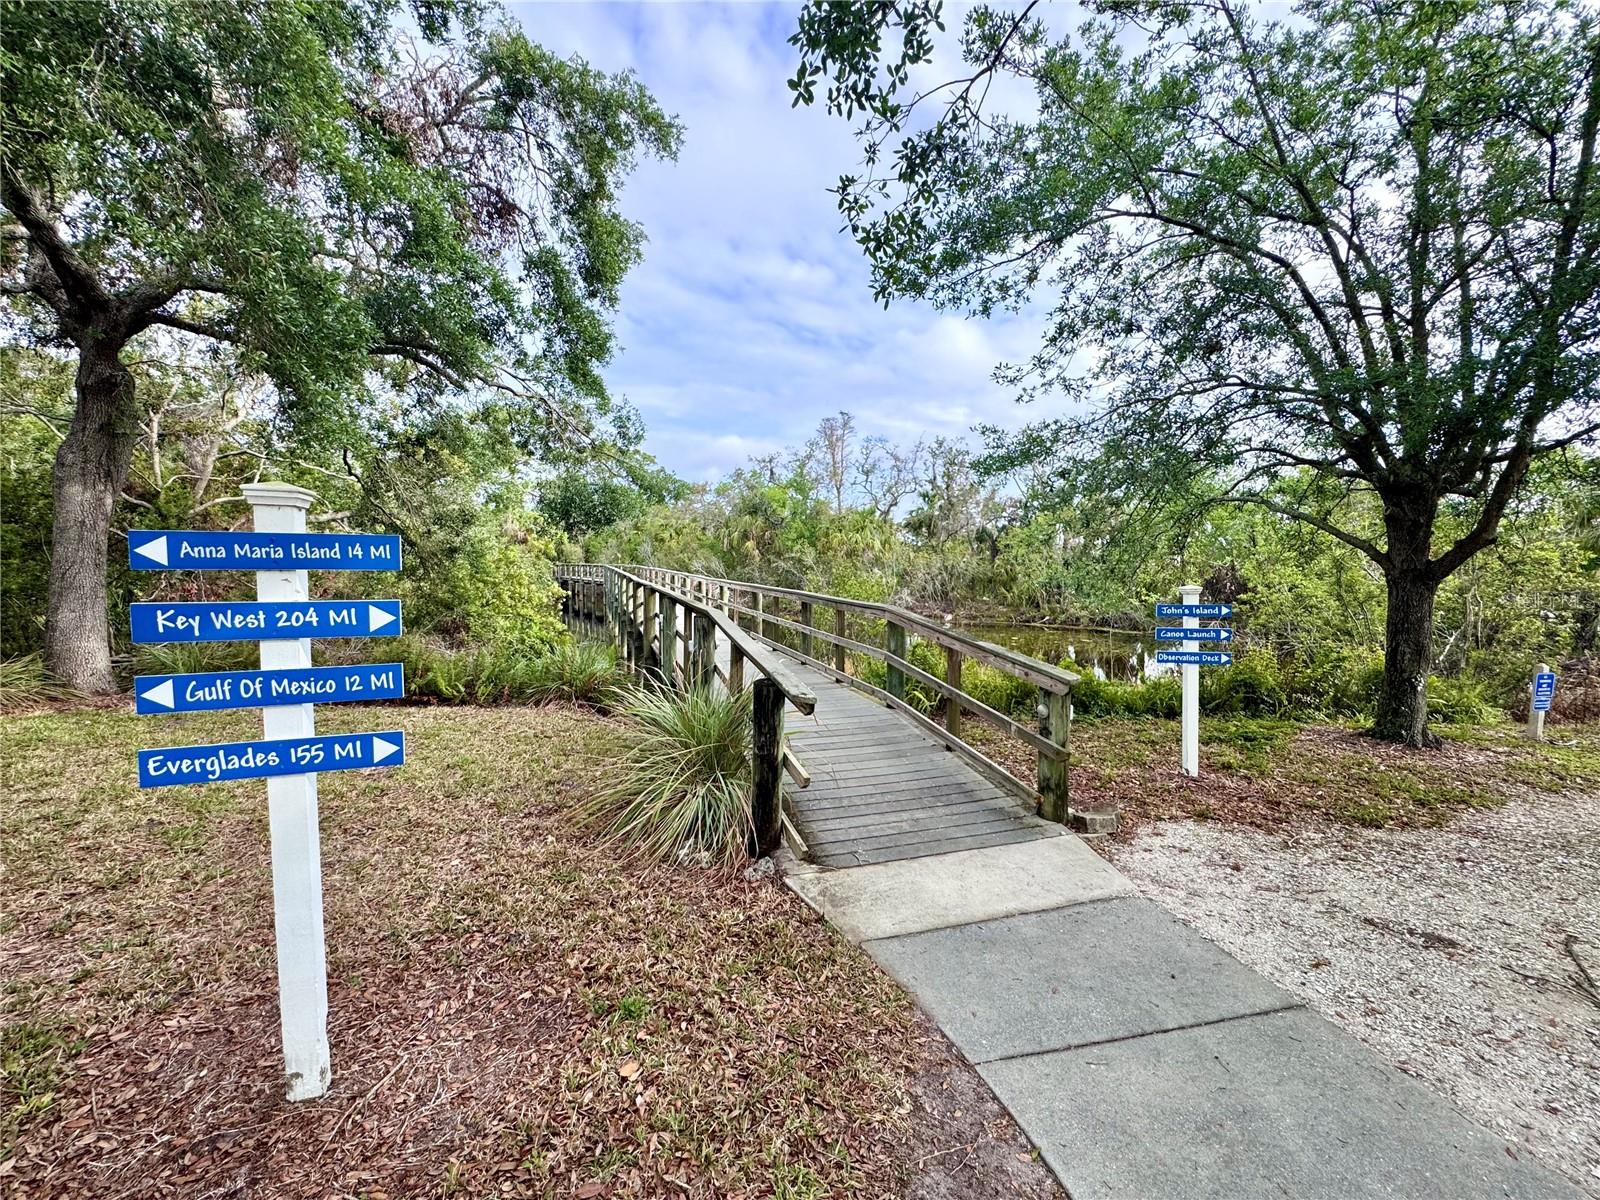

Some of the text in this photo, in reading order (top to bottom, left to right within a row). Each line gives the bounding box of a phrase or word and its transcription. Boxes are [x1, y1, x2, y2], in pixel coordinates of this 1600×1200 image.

[181, 541, 390, 559] Anna Maria Island 14 MI
[1161, 606, 1219, 615] John's Island
[157, 608, 356, 636] Key West 204 MI
[1160, 630, 1216, 638] Canoe Launch
[1159, 653, 1199, 662] Observation
[186, 672, 393, 701] Gulf Of Mexico 12 MI
[147, 741, 361, 780] Everglades 155 MI
